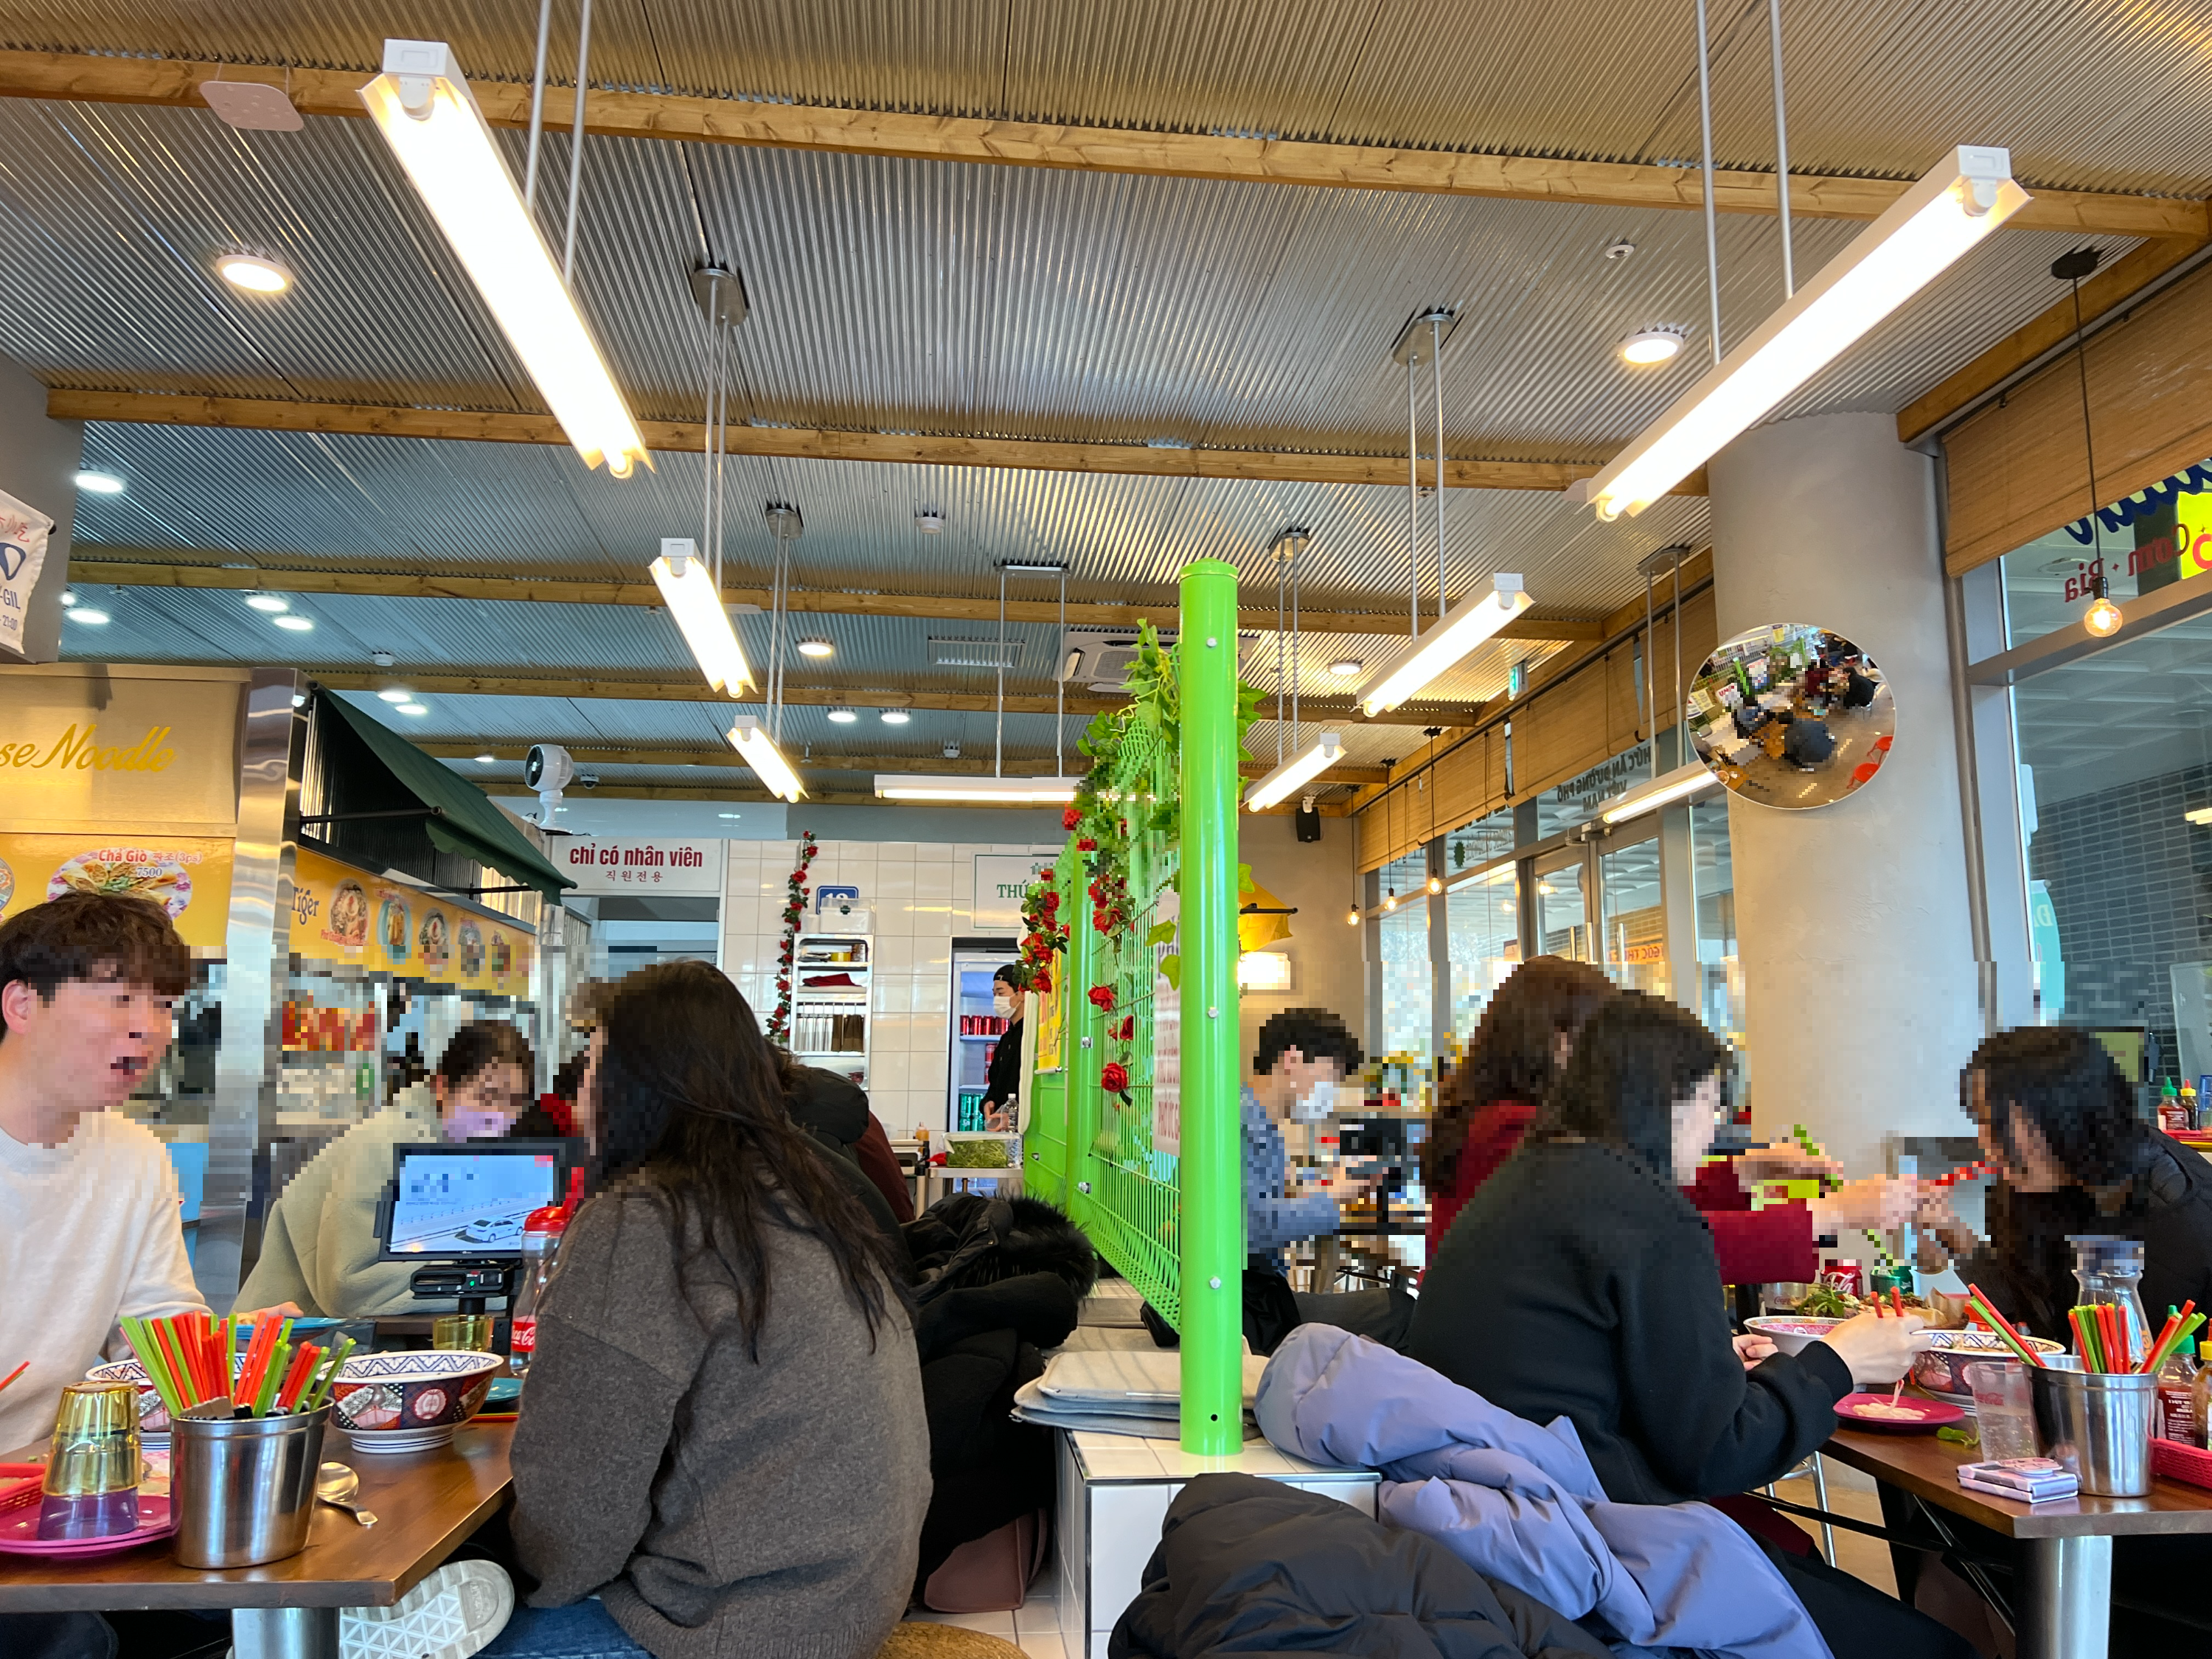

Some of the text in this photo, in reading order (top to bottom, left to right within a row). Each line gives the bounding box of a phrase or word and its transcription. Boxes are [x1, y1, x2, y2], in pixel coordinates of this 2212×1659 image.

[31, 723, 178, 772] Noodle
[98, 849, 122, 861] Chả
[126, 849, 147, 862] Giò
[570, 842, 703, 867] chỉ có nhân viên
[136, 867, 162, 877] 7500
[291, 886, 320, 925] Tiger
